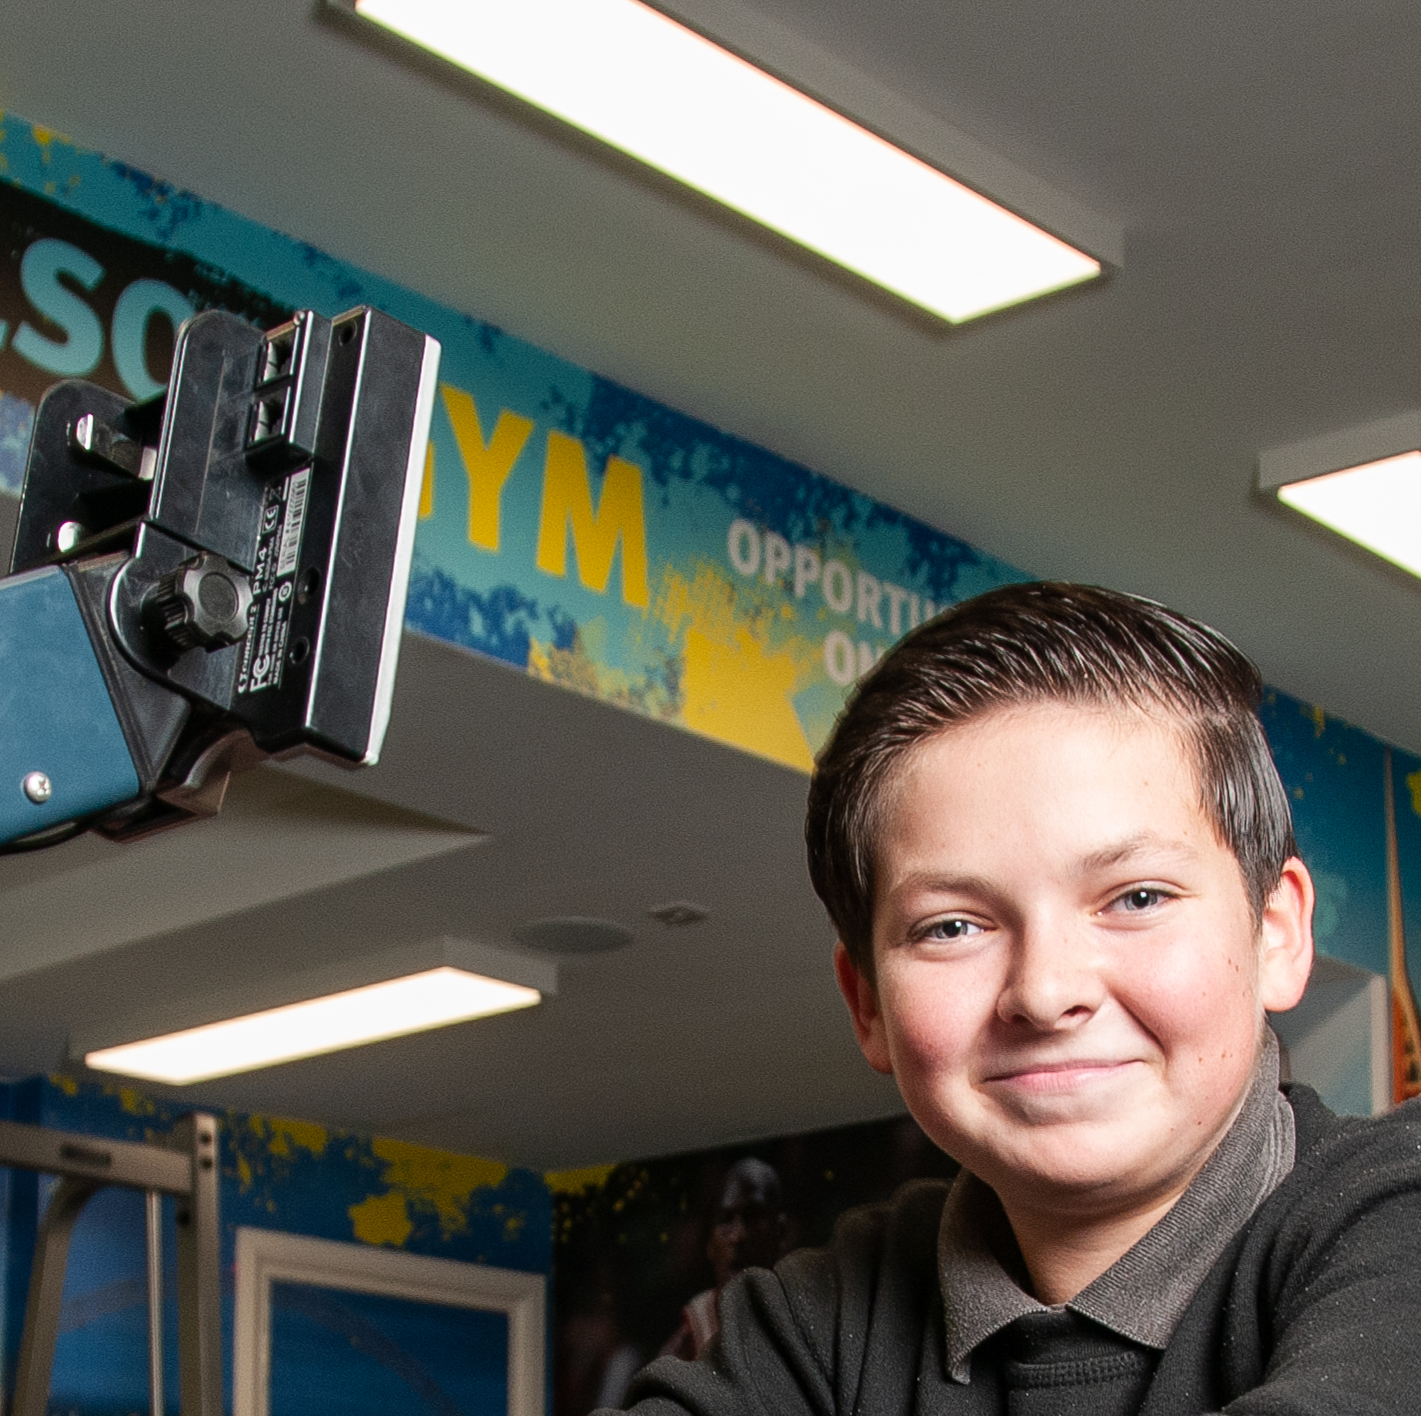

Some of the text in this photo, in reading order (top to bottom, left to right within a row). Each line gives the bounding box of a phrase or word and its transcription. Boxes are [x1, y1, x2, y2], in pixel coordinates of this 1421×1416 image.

[419, 383, 649, 608] YM
[252, 546, 268, 595] PM4
[728, 518, 952, 636] OPPORTU
